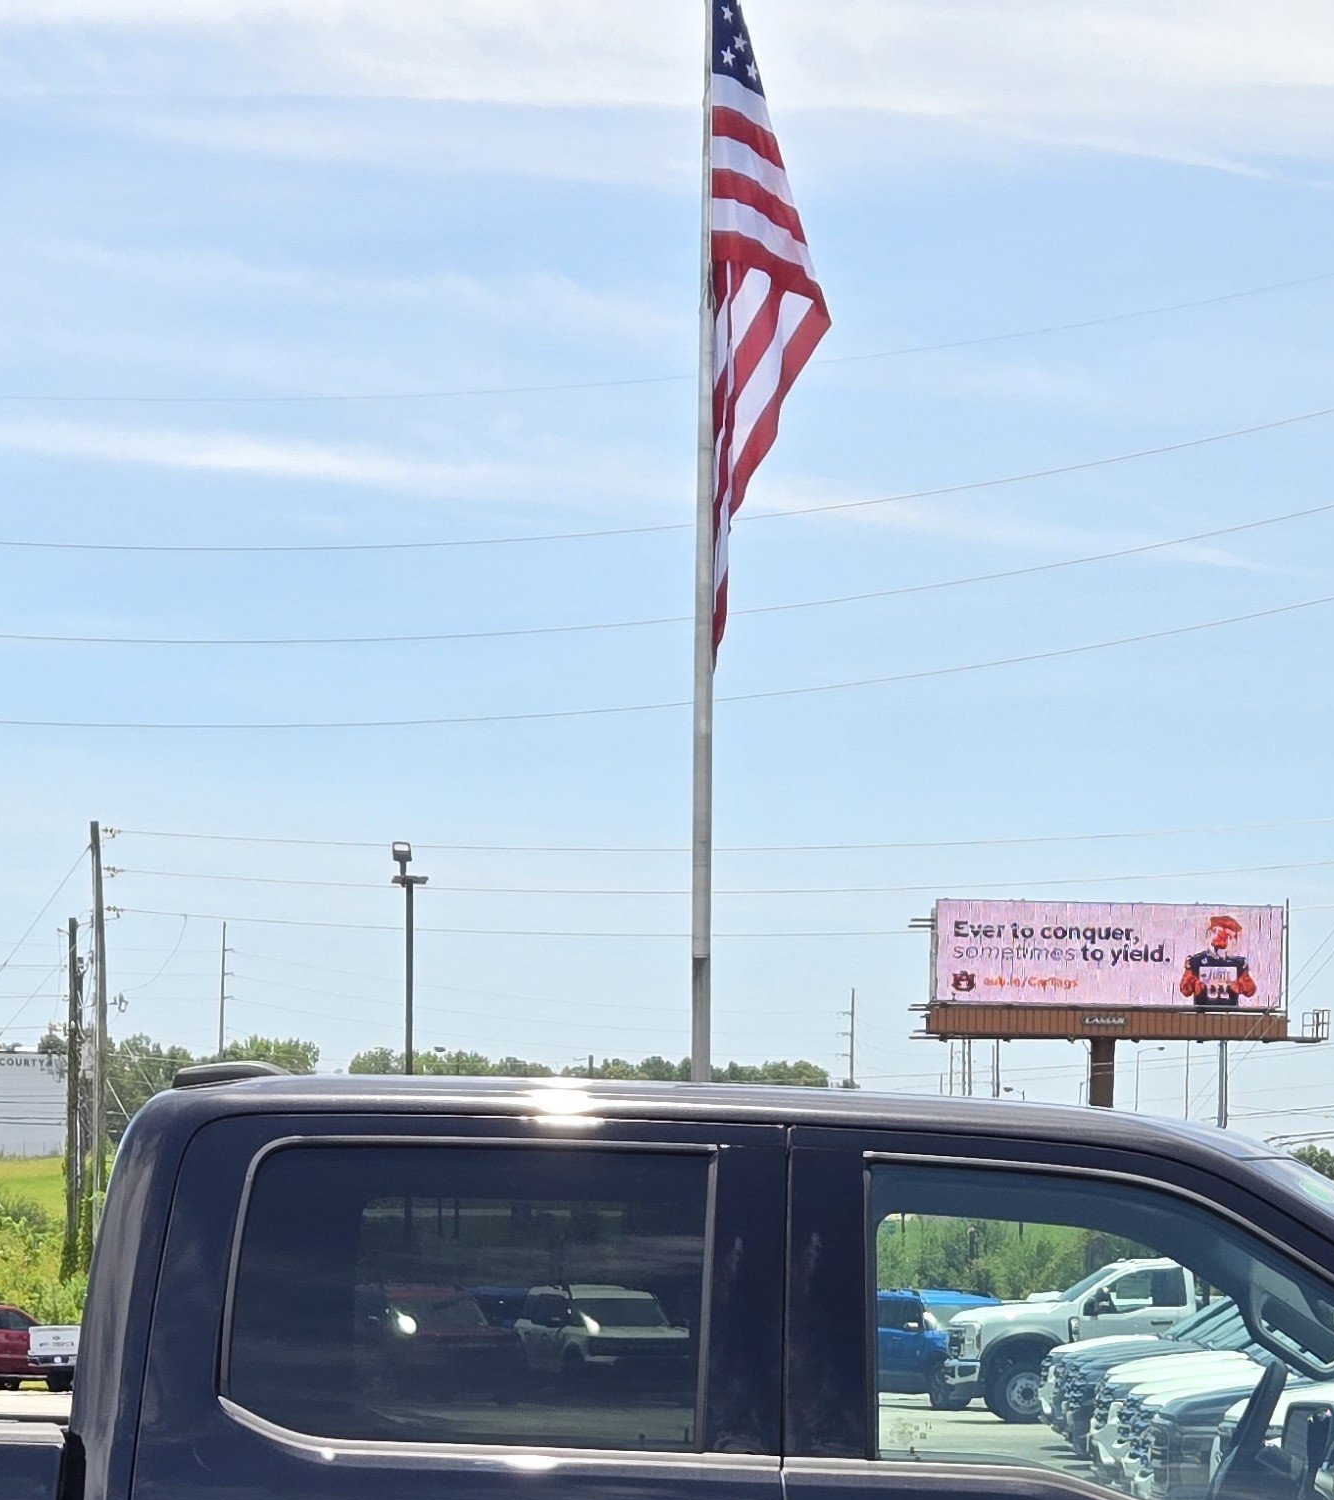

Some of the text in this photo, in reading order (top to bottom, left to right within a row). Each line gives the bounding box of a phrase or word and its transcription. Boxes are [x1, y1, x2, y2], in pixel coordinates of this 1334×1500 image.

[954, 920, 1005, 939] Ever
[1040, 925, 1140, 945] conquer,
[952, 943, 1171, 966] sometimes to yield.
